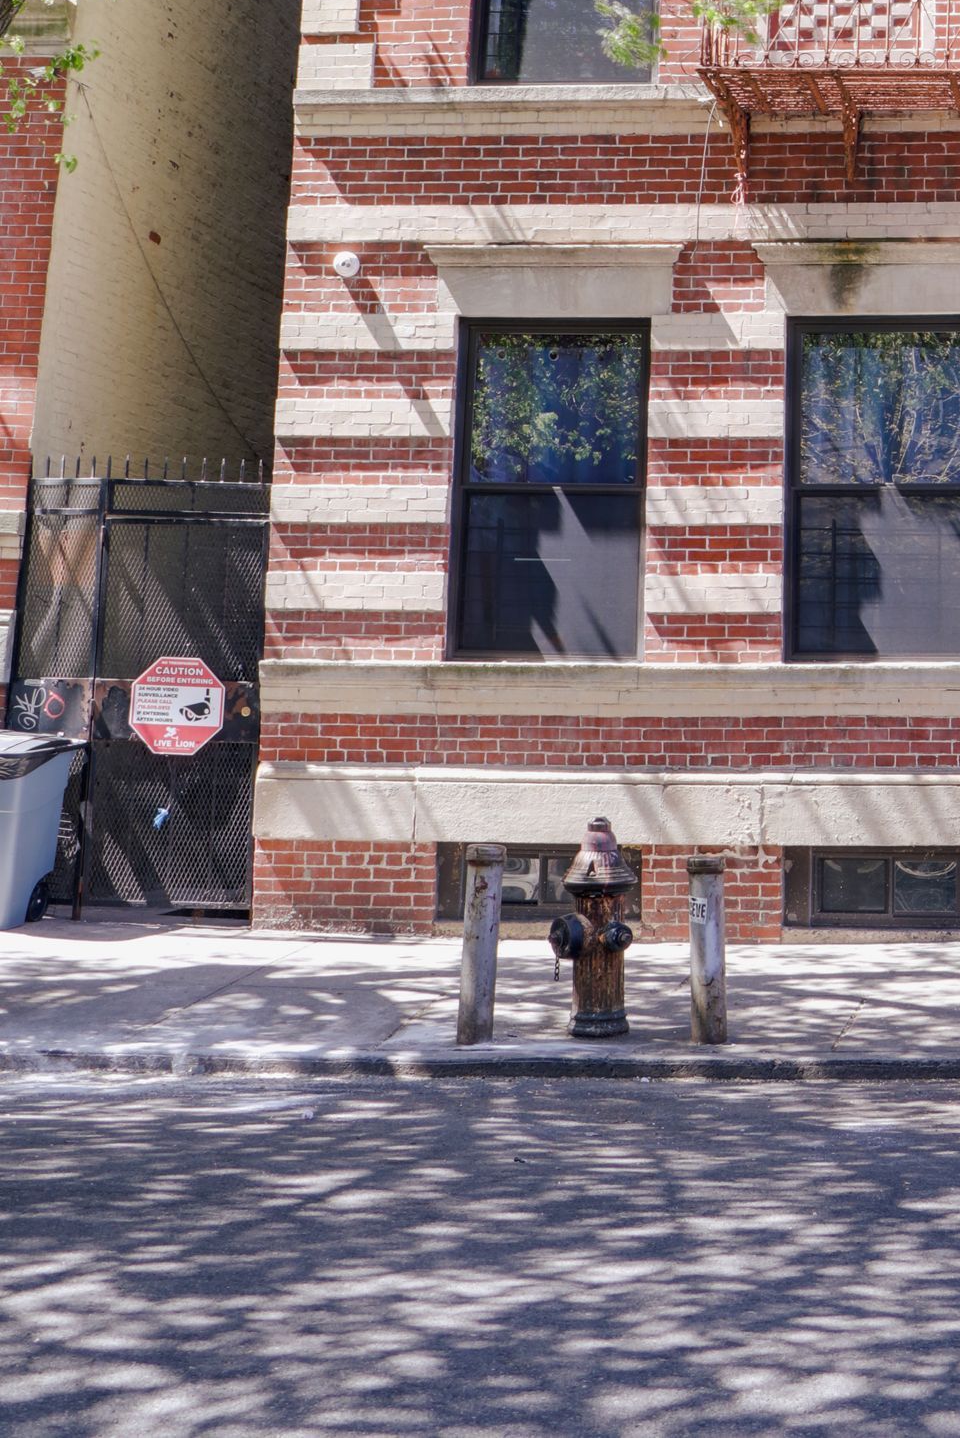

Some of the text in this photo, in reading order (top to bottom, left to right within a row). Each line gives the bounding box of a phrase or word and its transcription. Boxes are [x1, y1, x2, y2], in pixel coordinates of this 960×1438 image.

[155, 666, 204, 676] CAUTION
[176, 677, 214, 685] ENTERING
[153, 739, 195, 748] LIVE LION
